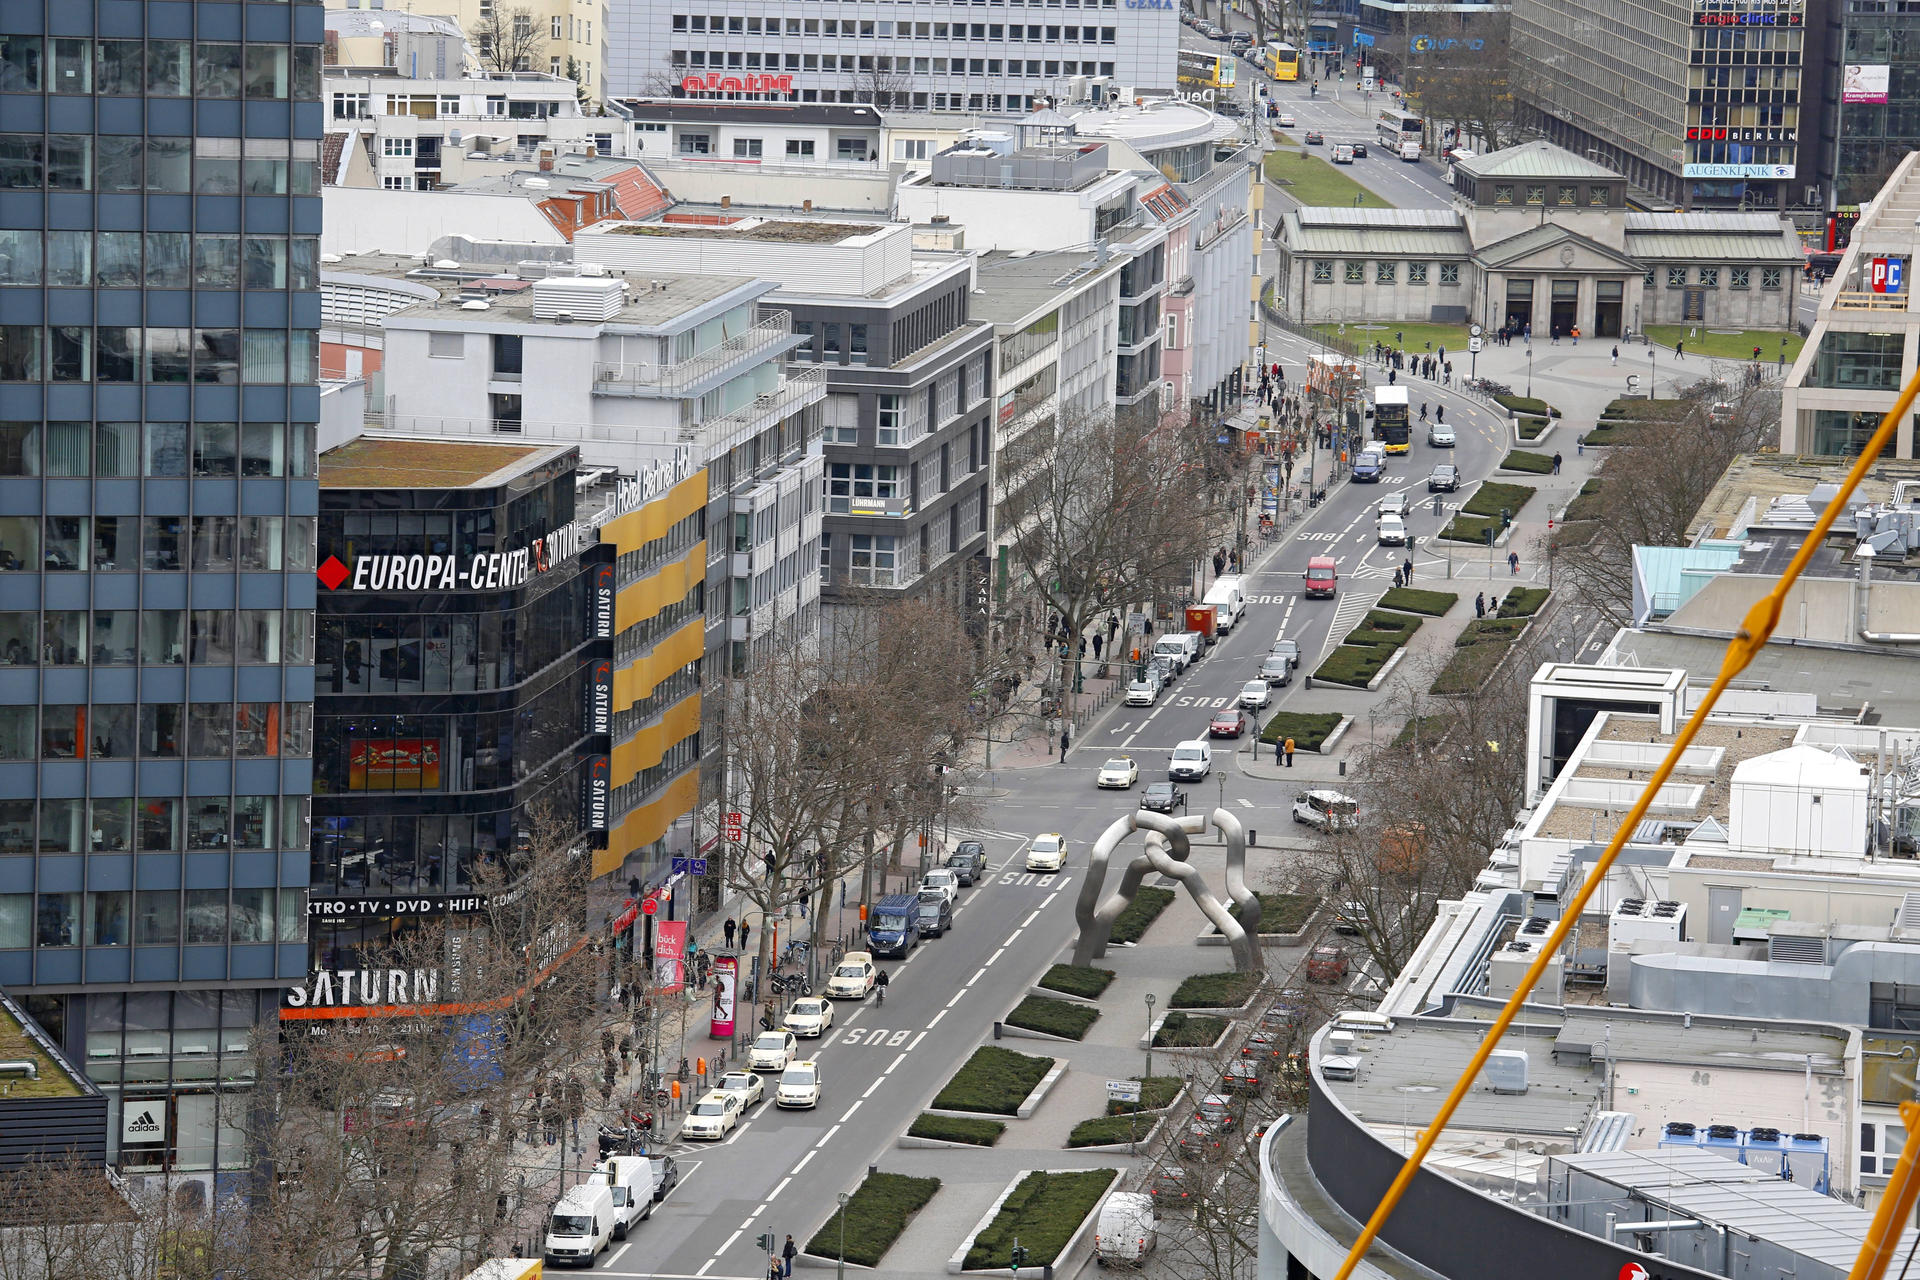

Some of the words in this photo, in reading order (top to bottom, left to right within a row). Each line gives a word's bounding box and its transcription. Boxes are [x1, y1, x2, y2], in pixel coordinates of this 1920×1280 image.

[1125, 0, 1174, 9] GEMA
[1699, 11, 1777, 26] angioclinic
[1687, 128, 1727, 140] CDU
[1732, 132, 1796, 140] BERLIN
[1687, 165, 1769, 176] AUGENKLINIK
[617, 469, 642, 516] Hotel
[642, 458, 676, 502] Berliner
[1379, 476, 1406, 484] BU
[1296, 532, 1337, 541] BUS
[352, 545, 530, 591] EUROPA-CENTER
[546, 519, 579, 568] SATURN
[978, 577, 988, 615] ZARA
[1246, 595, 1284, 604] BUS
[597, 588, 611, 637] SATURN
[595, 684, 609, 733] SATURN
[1176, 696, 1228, 707] BUS
[592, 780, 606, 829] SATURN
[998, 872, 1058, 887] BUS
[359, 901, 379, 913] TV
[396, 900, 431, 913] DVD
[449, 898, 479, 911] HIFI
[658, 934, 676, 945] bück
[287, 968, 438, 1007] SATURN
[841, 1028, 912, 1046] BUS
[128, 1124, 160, 1132] adidas
